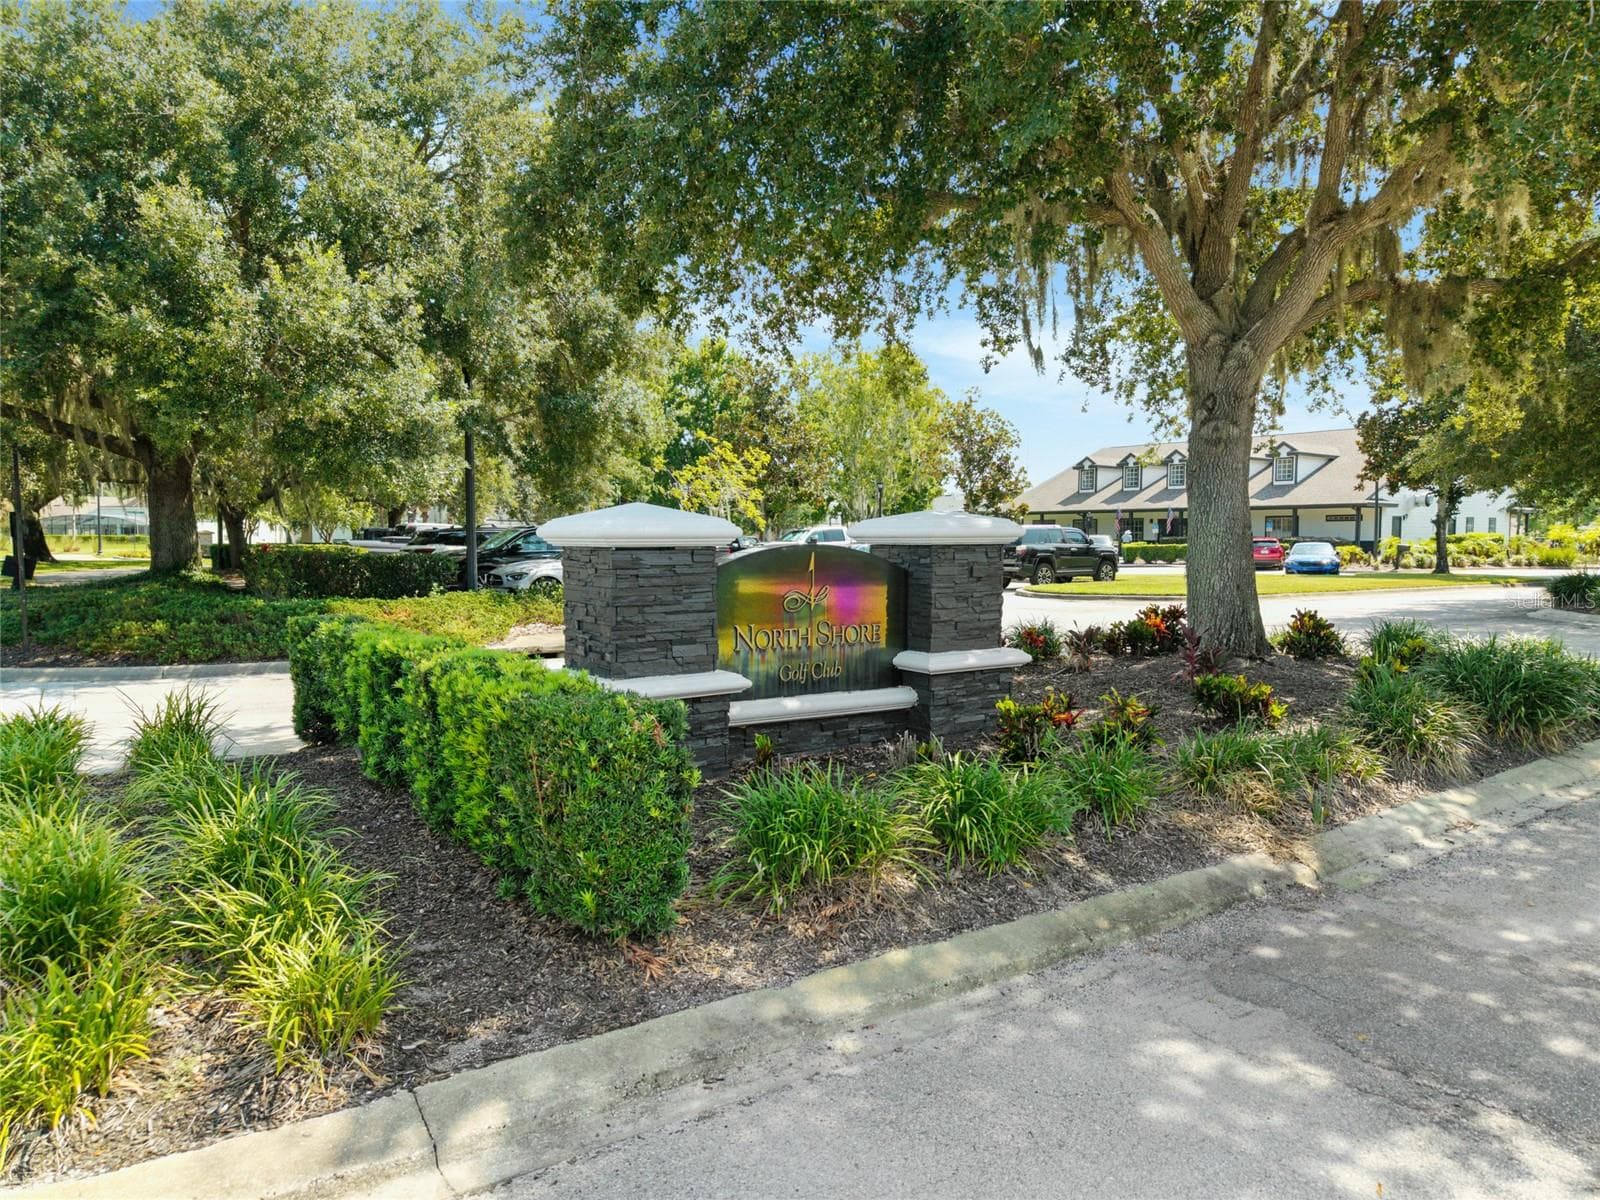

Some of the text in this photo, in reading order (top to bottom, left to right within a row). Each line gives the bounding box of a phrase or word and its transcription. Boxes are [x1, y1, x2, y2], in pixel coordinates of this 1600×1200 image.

[734, 620, 882, 652] NORTH SHORE
[780, 661, 842, 685] Golf Club
